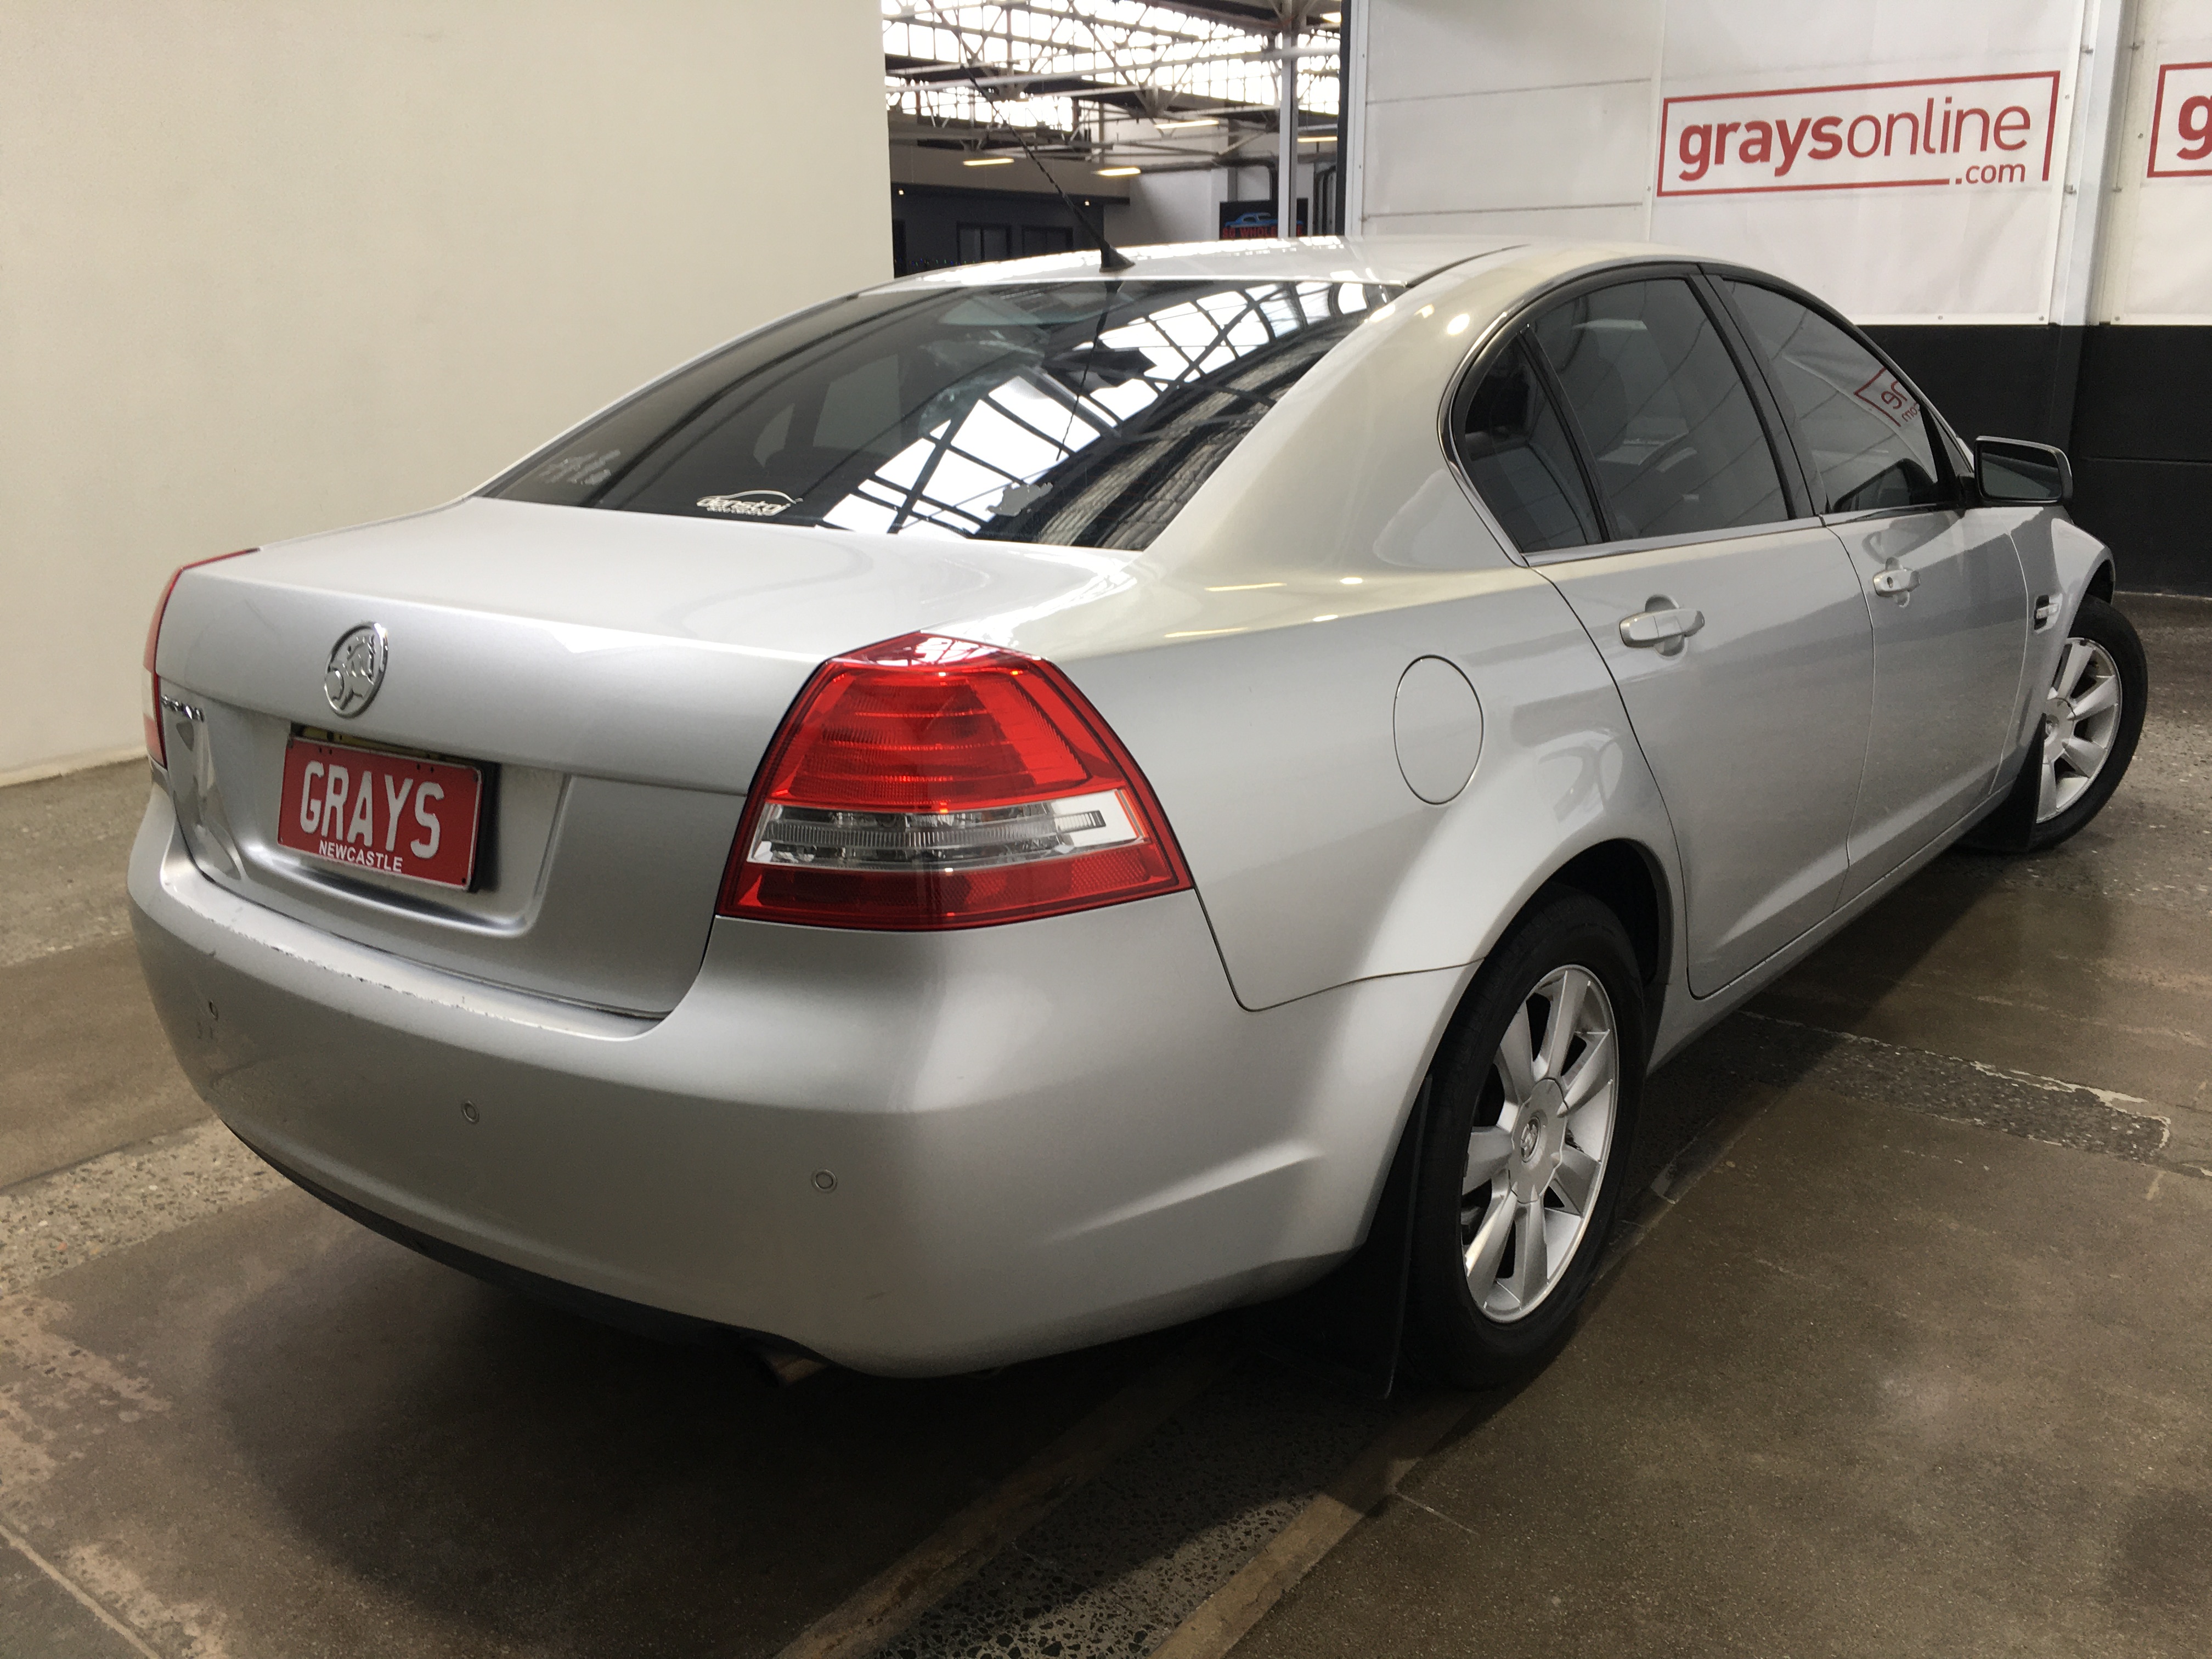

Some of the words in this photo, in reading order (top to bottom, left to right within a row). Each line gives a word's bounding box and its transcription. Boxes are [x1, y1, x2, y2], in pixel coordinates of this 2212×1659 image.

[1679, 97, 2031, 181] graysonline
[1955, 162, 2025, 185] .com
[300, 760, 444, 859] GRAYS
[319, 839, 403, 873] NEWCASTLE
